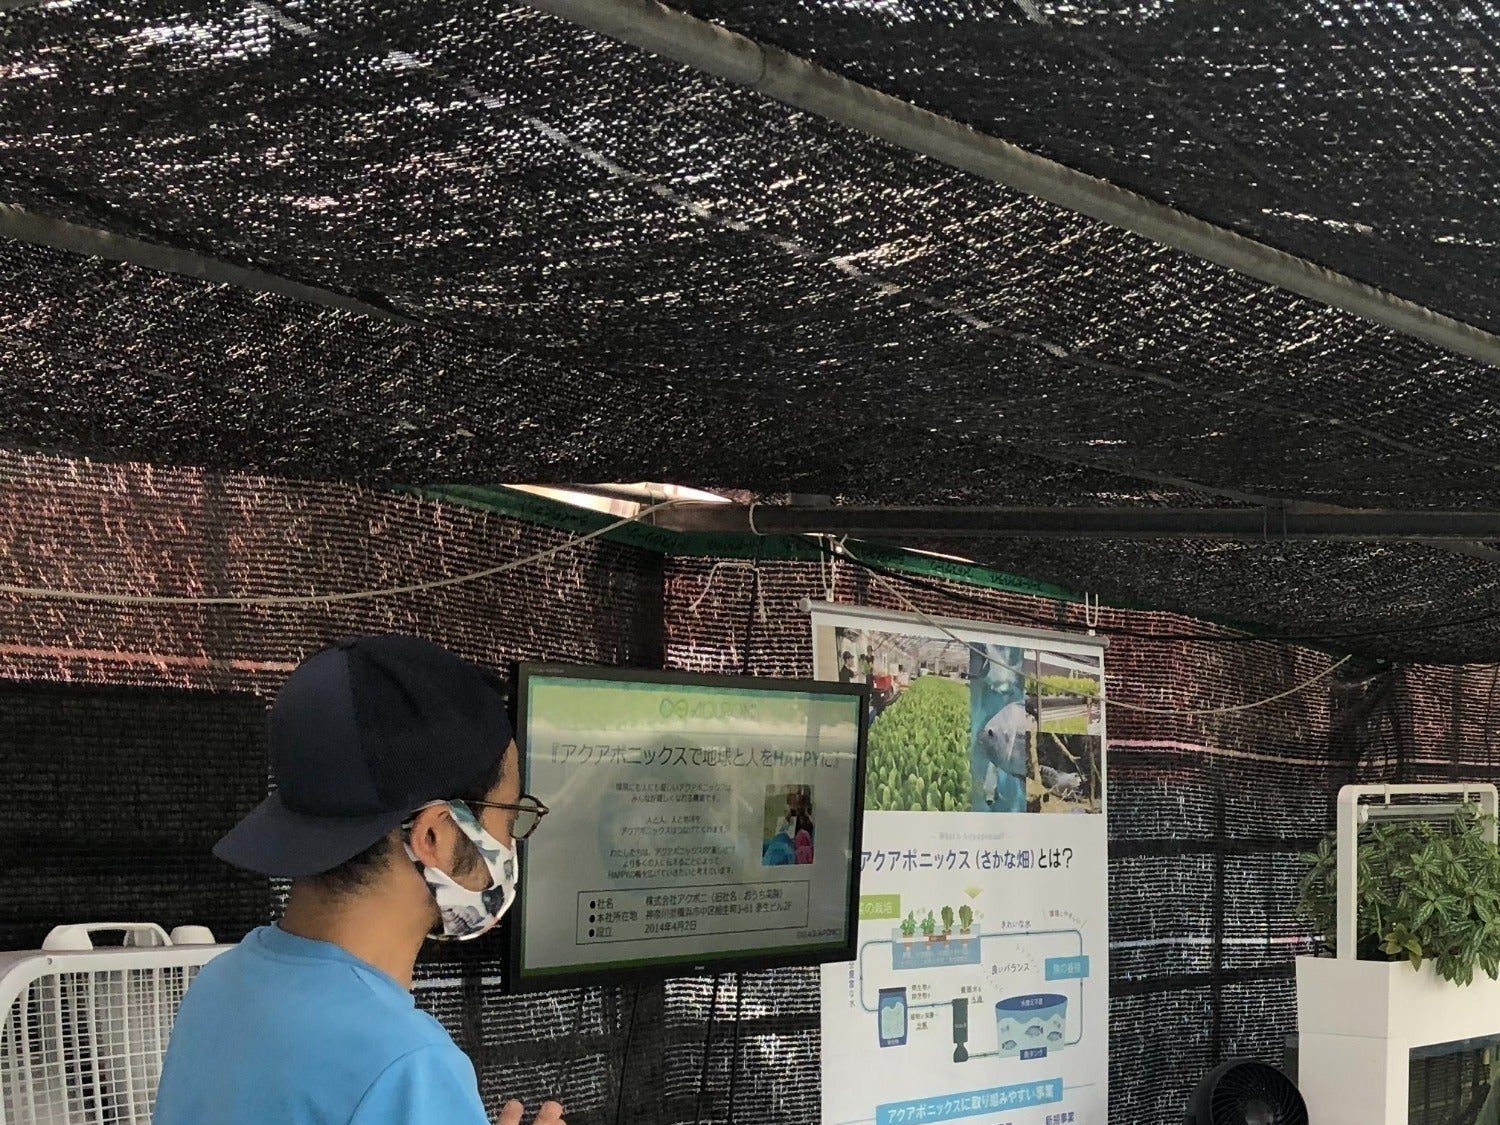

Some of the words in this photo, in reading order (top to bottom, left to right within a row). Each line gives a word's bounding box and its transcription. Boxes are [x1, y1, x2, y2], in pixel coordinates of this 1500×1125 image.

[644, 920, 697, 934] 2014年4月2日
[887, 1083, 1054, 1124] アクアポニックスに取り組みやすい事業
